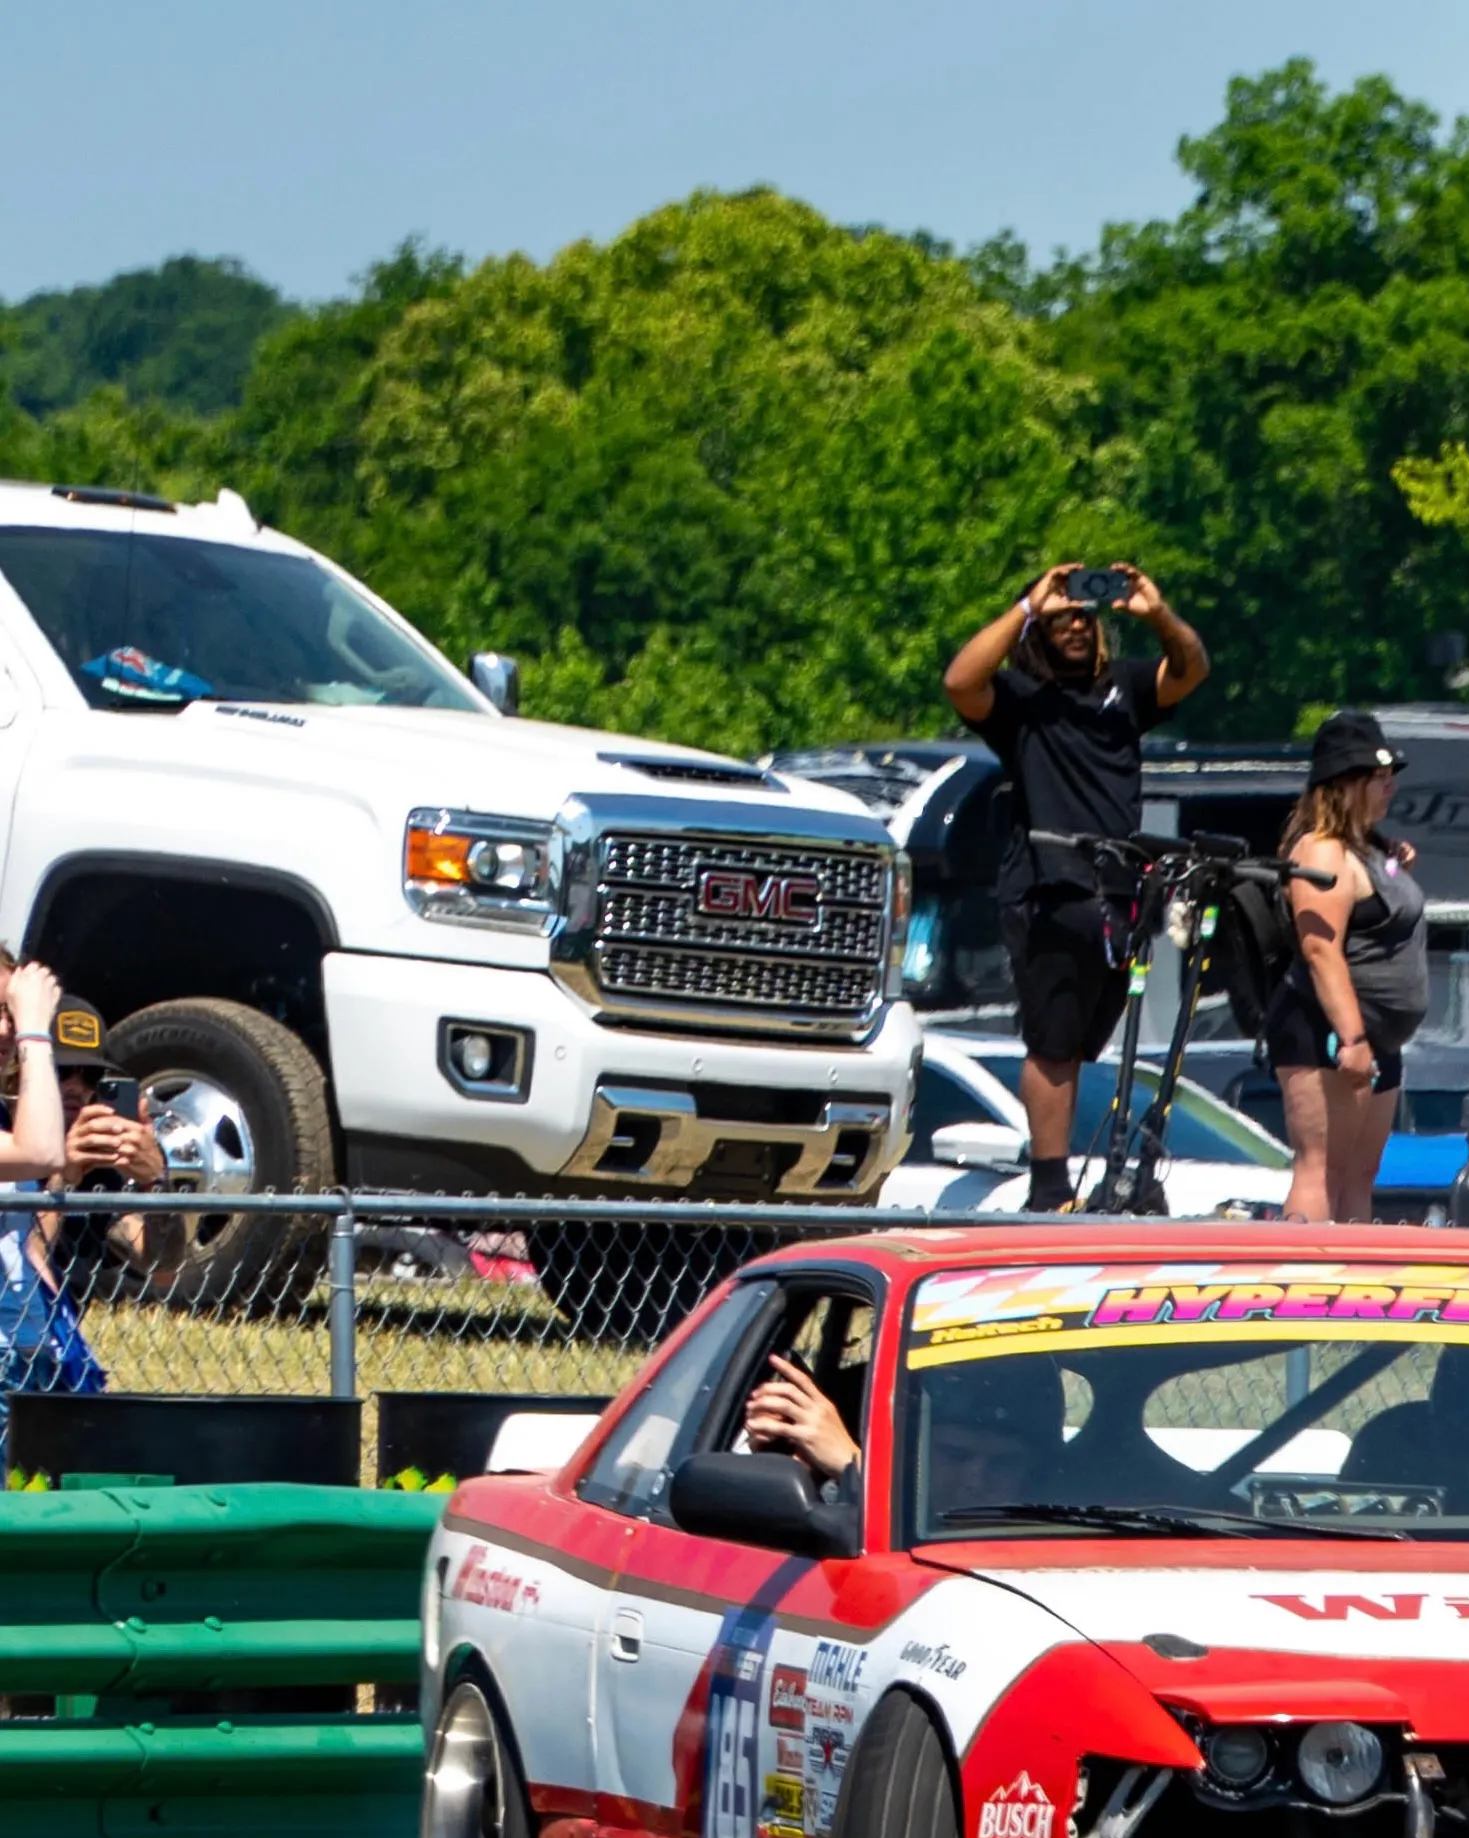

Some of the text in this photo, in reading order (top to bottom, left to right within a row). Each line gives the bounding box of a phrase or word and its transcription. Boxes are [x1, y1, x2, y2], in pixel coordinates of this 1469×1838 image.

[698, 871, 819, 923] GMC
[929, 1315, 1063, 1345] Haltech
[809, 1641, 867, 1693] MAHLE
